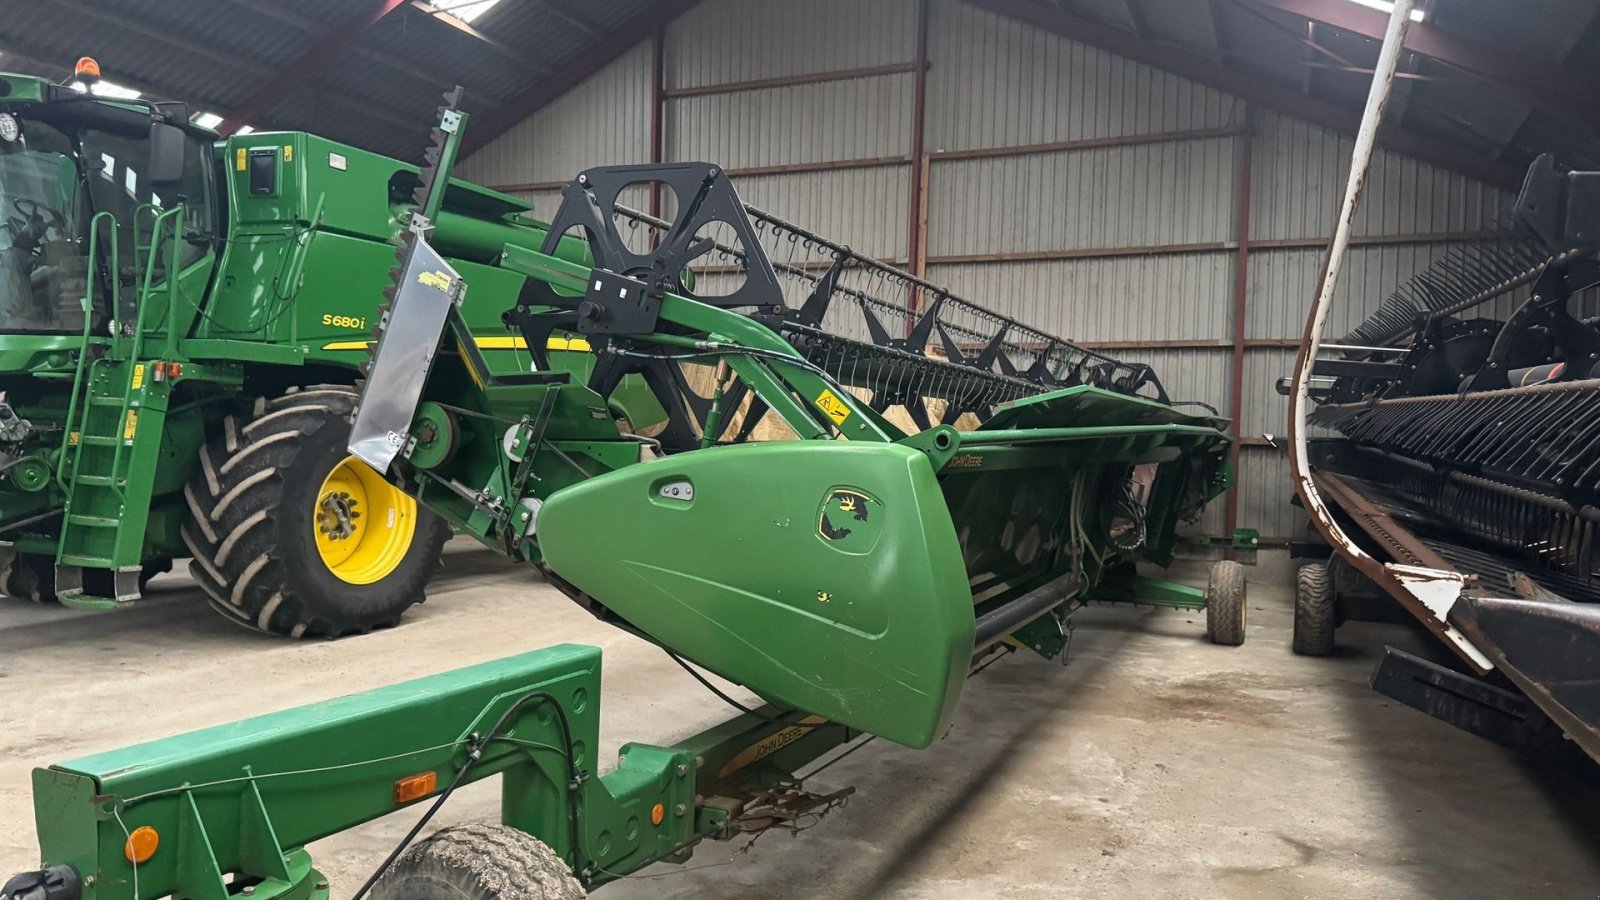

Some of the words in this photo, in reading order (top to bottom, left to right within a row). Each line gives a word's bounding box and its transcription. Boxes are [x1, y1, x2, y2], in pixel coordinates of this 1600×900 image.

[322, 314, 365, 330] S680i
[754, 738, 777, 760] JOHN
[777, 726, 802, 747] DEERE
